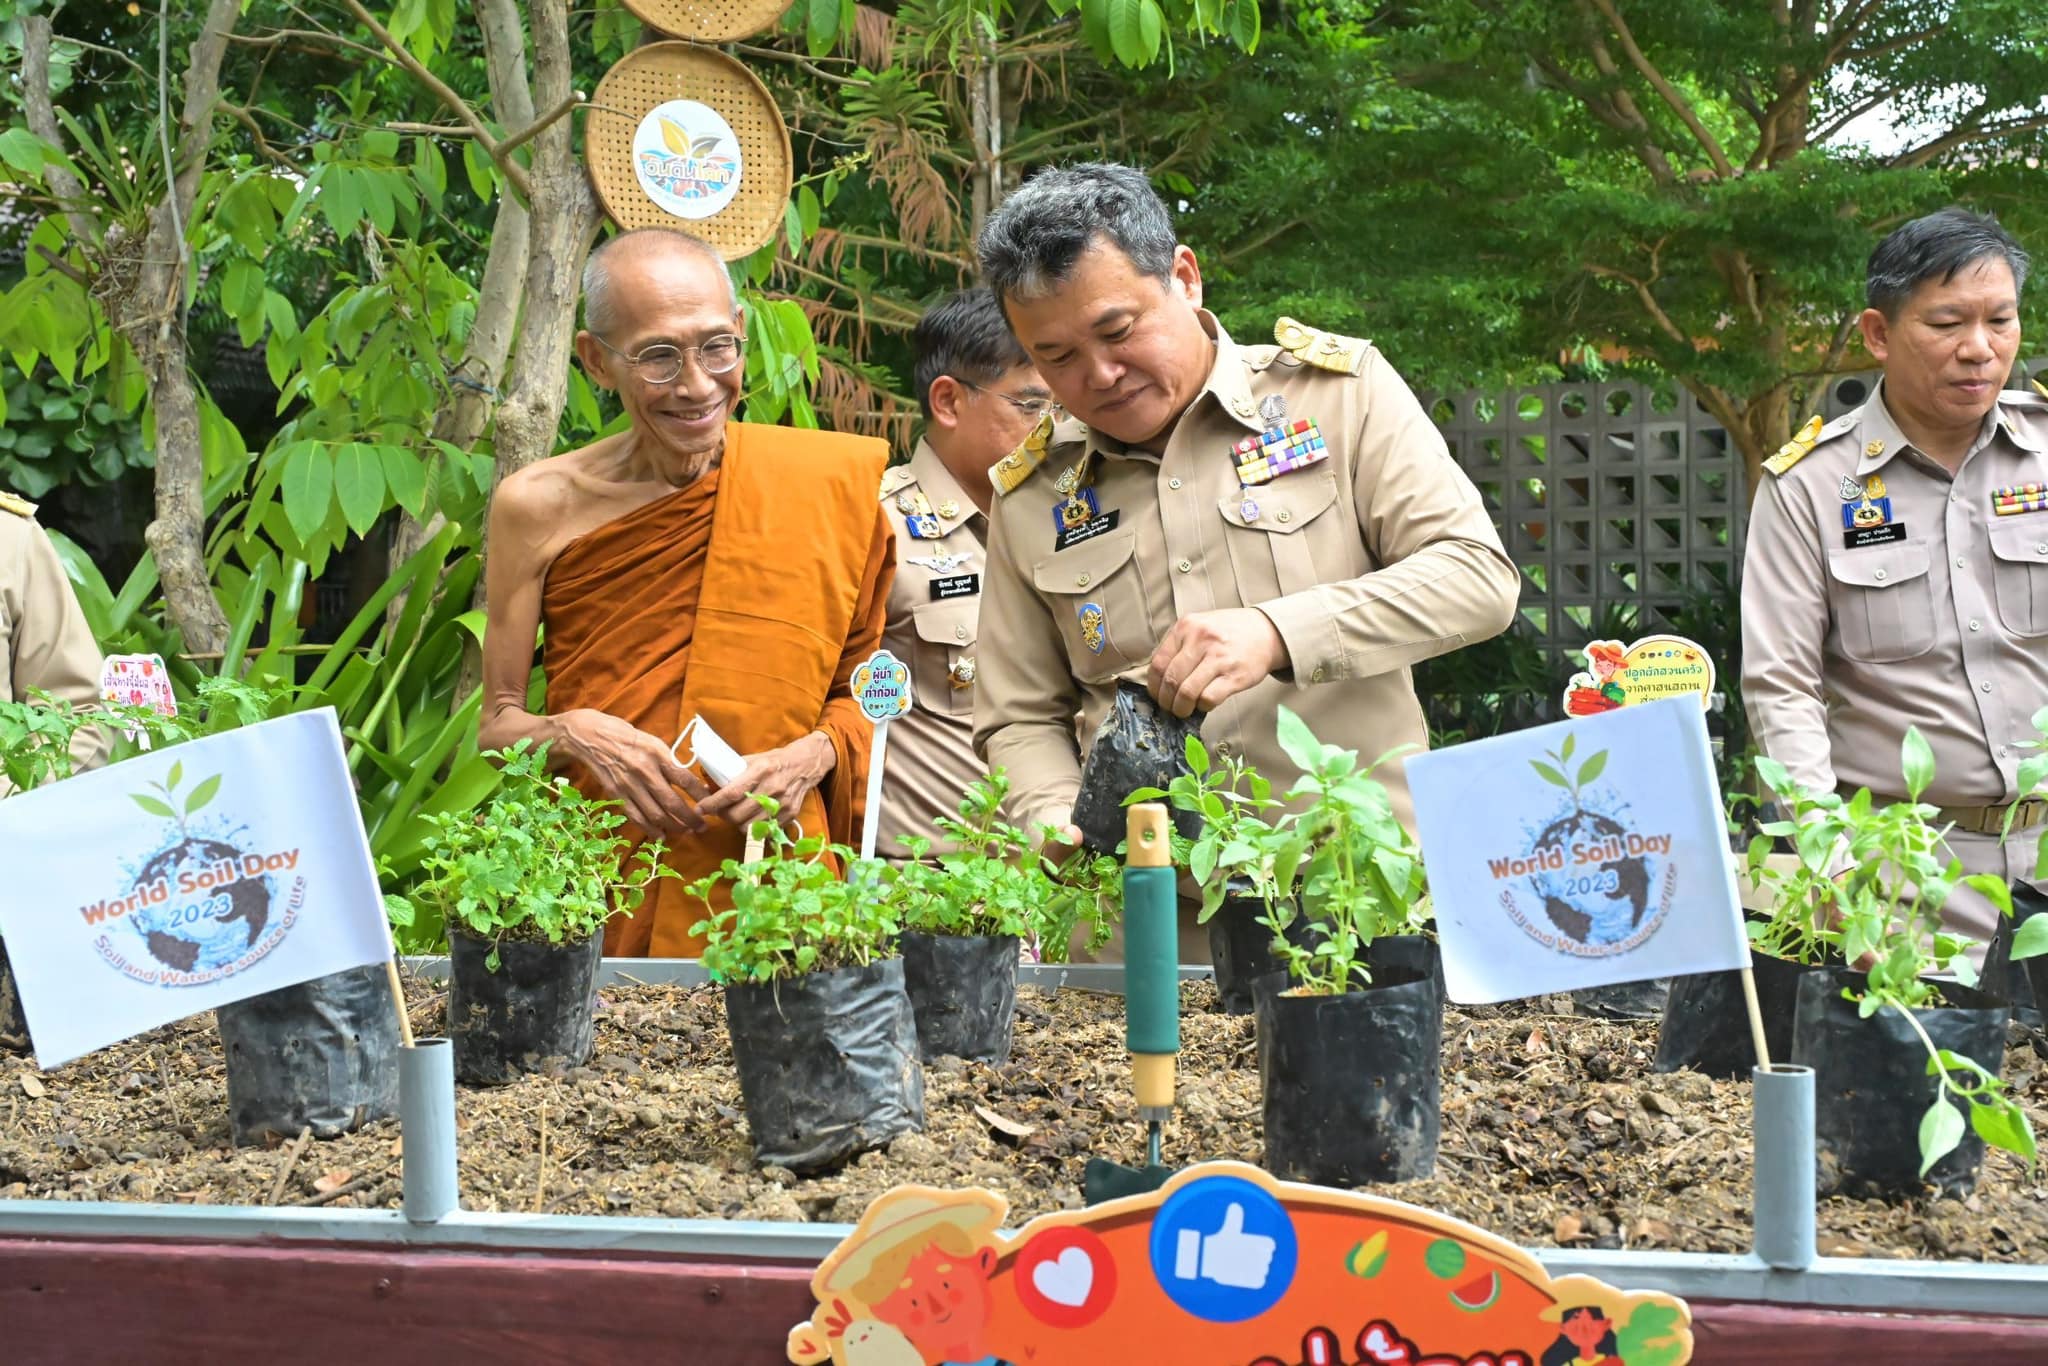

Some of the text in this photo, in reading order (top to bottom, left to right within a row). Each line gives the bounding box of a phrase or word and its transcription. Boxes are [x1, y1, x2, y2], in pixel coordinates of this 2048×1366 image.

[873, 666, 892, 684] ผู้นำ
[1624, 663, 1703, 682] ปลูกผักสวนครัว
[865, 684, 898, 698] ทำก่อน
[1626, 682, 1701, 693] จากศาสนสถาน
[1488, 833, 1671, 879] World Soil Day
[80, 848, 300, 926] World Soil Day
[1566, 872, 1617, 896] 2023
[170, 895, 230, 928] 2023
[1499, 889, 1525, 926] Soil
[1524, 923, 1554, 945] and
[95, 935, 122, 967] Soil
[124, 962, 155, 982] and
[237, 926, 284, 968] source
